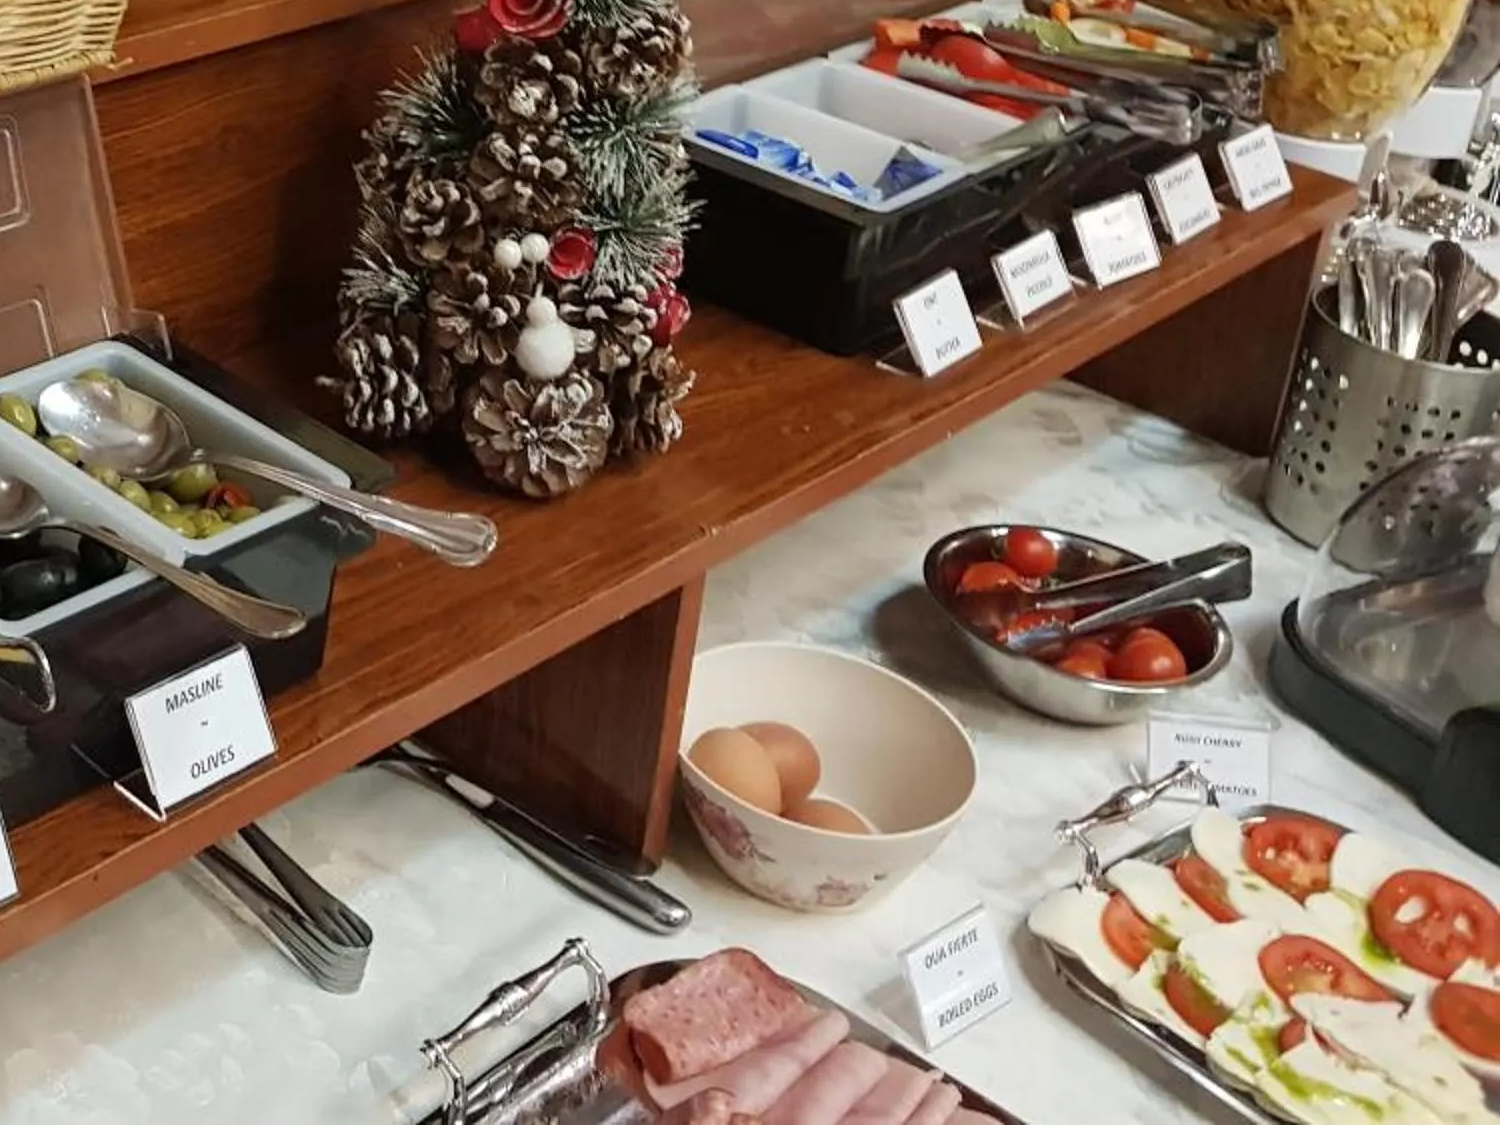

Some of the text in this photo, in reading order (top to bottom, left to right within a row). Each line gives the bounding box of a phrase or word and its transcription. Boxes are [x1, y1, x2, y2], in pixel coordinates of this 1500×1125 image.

[165, 673, 224, 714] MASLINE
[190, 745, 235, 779] OLIVES
[973, 982, 999, 1007] EGGS
